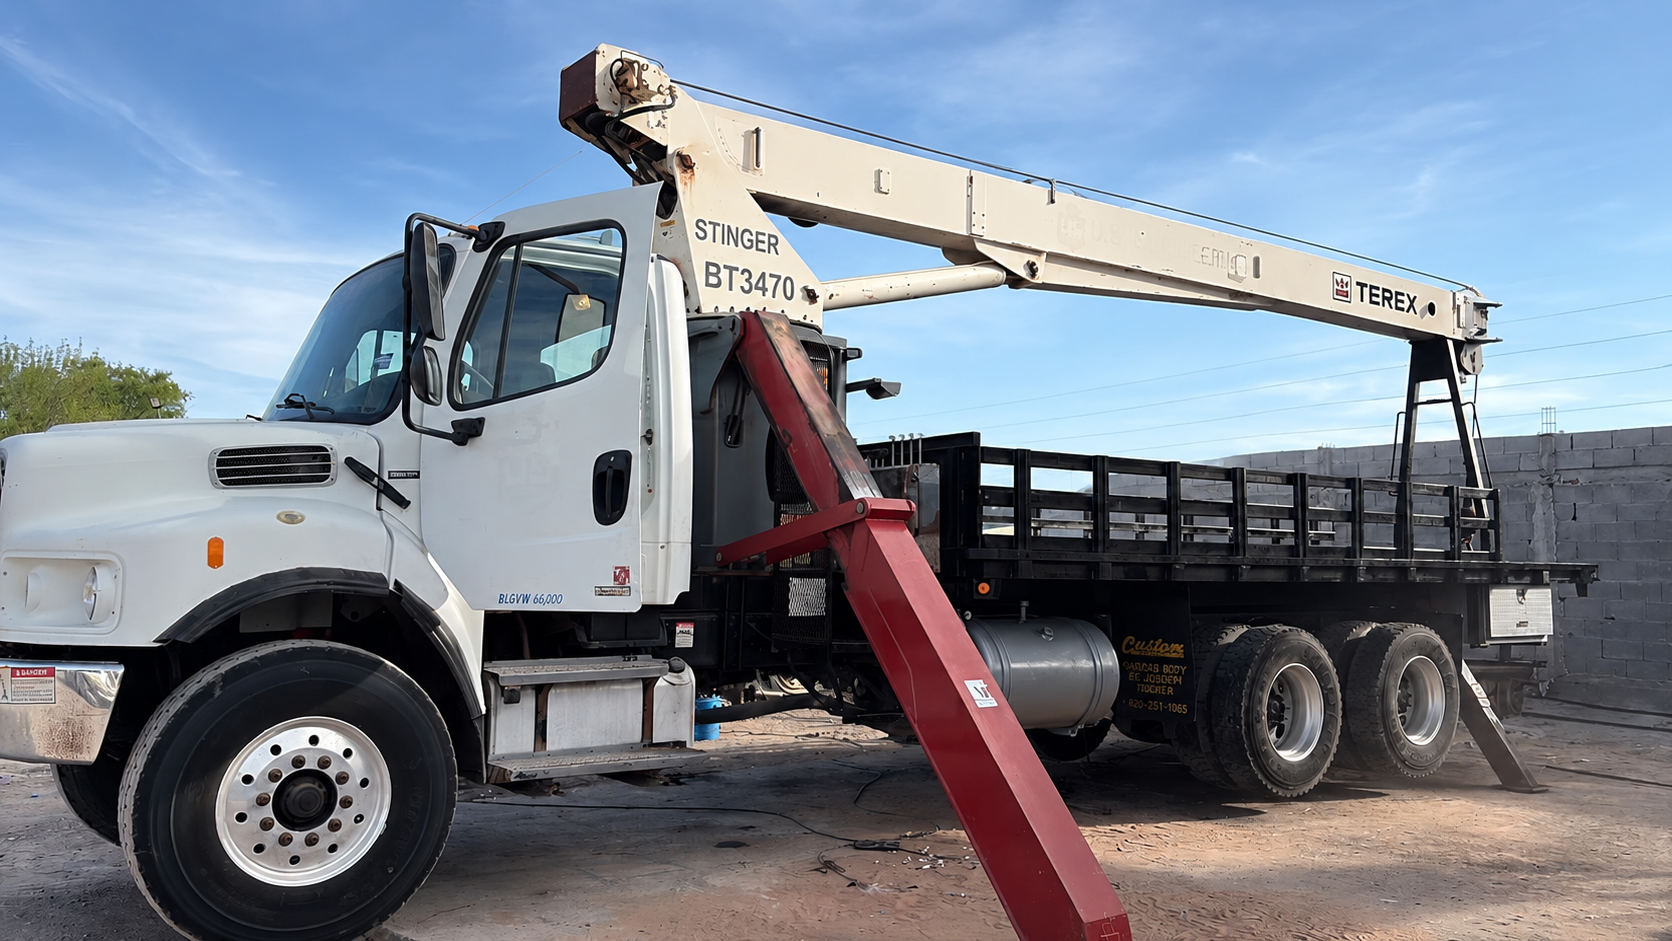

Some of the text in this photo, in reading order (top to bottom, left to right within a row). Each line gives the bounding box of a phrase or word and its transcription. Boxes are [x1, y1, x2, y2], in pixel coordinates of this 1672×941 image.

[695, 218, 779, 255] STINGER
[705, 261, 795, 301] BT3470
[1355, 281, 1417, 315] TEREX
[498, 593, 563, 606] BLGVW 66,000
[1121, 636, 1184, 655] Custom
